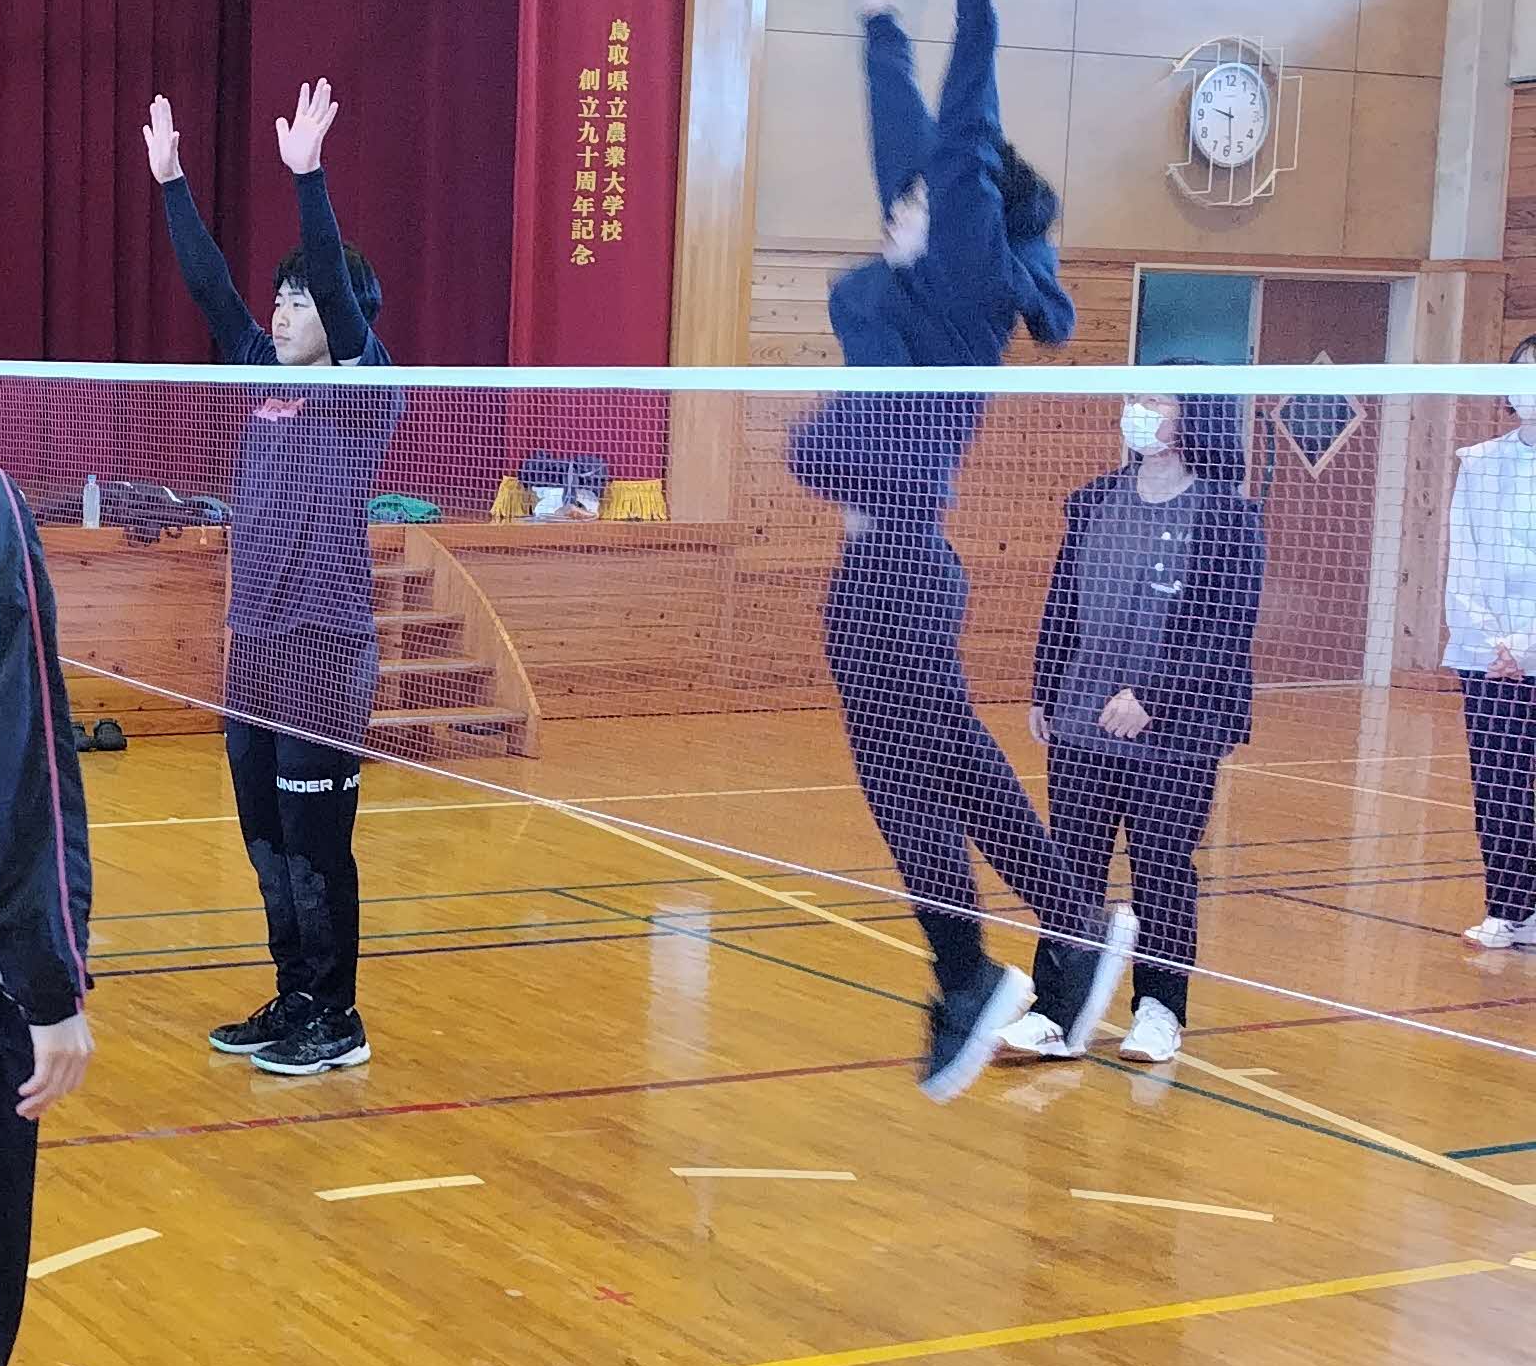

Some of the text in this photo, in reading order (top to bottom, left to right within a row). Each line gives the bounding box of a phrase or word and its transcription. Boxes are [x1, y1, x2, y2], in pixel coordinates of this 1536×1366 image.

[1213, 80, 1222, 91] 11
[1225, 75, 1237, 87] 12
[1201, 91, 1213, 103] 10
[1250, 93, 1256, 105] 2
[1198, 108, 1205, 120] 9
[600, 18, 631, 242] 鳥取県立農業大学校
[1201, 127, 1208, 138] 8
[1246, 129, 1253, 139] 4
[1213, 140, 1218, 152] 7
[1223, 145, 1231, 157] 6
[1237, 141, 1244, 153] 5
[570, 67, 601, 266] 創立九十周年記念
[276, 775, 333, 793] UNDER
